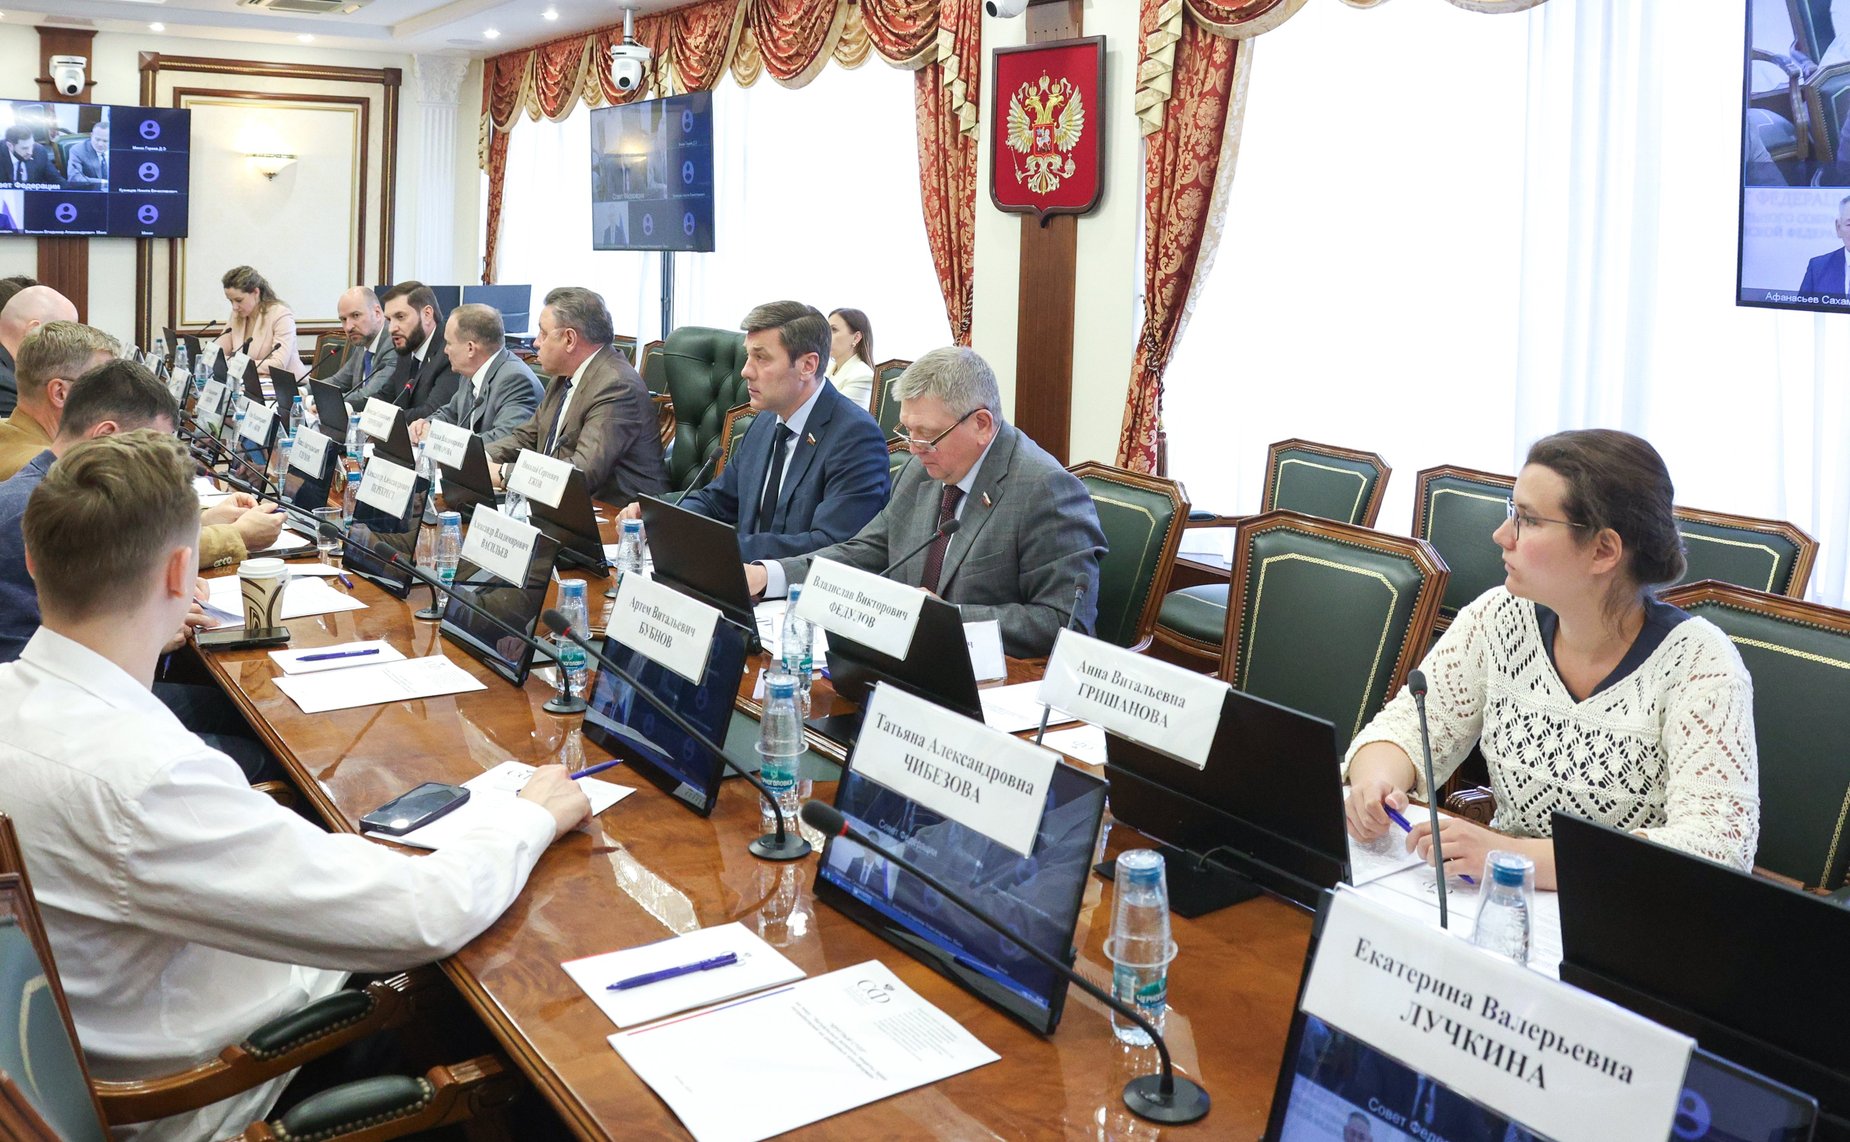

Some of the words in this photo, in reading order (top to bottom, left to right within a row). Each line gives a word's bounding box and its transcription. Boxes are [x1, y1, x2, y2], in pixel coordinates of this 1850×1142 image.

[14, 182, 61, 191] Федерации
[1765, 291, 1819, 304] Афанасьев
[480, 538, 509, 559] ВАСИЛЬЕВ
[629, 595, 652, 616] Артем
[651, 605, 696, 638] Витальевич
[812, 575, 854, 600] Владислав
[855, 591, 908, 621] Викторович
[829, 601, 876, 629] ФЕДУЛОВ
[638, 621, 673, 649] БУБНОВ
[1077, 660, 1109, 681] Анна
[1111, 669, 1186, 709] Витальевна
[1078, 682, 1168, 729] ГРИШАНОВА
[875, 712, 926, 748] Татьяна
[926, 737, 1035, 796] Александровна
[904, 753, 981, 804] ЧИБЕЗОВА
[1354, 937, 1473, 1011] Екатерина
[1480, 994, 1634, 1085] Валерьевна
[1399, 1000, 1547, 1090] ЛУЧКИНА
[1367, 1097, 1407, 1127] Совет
